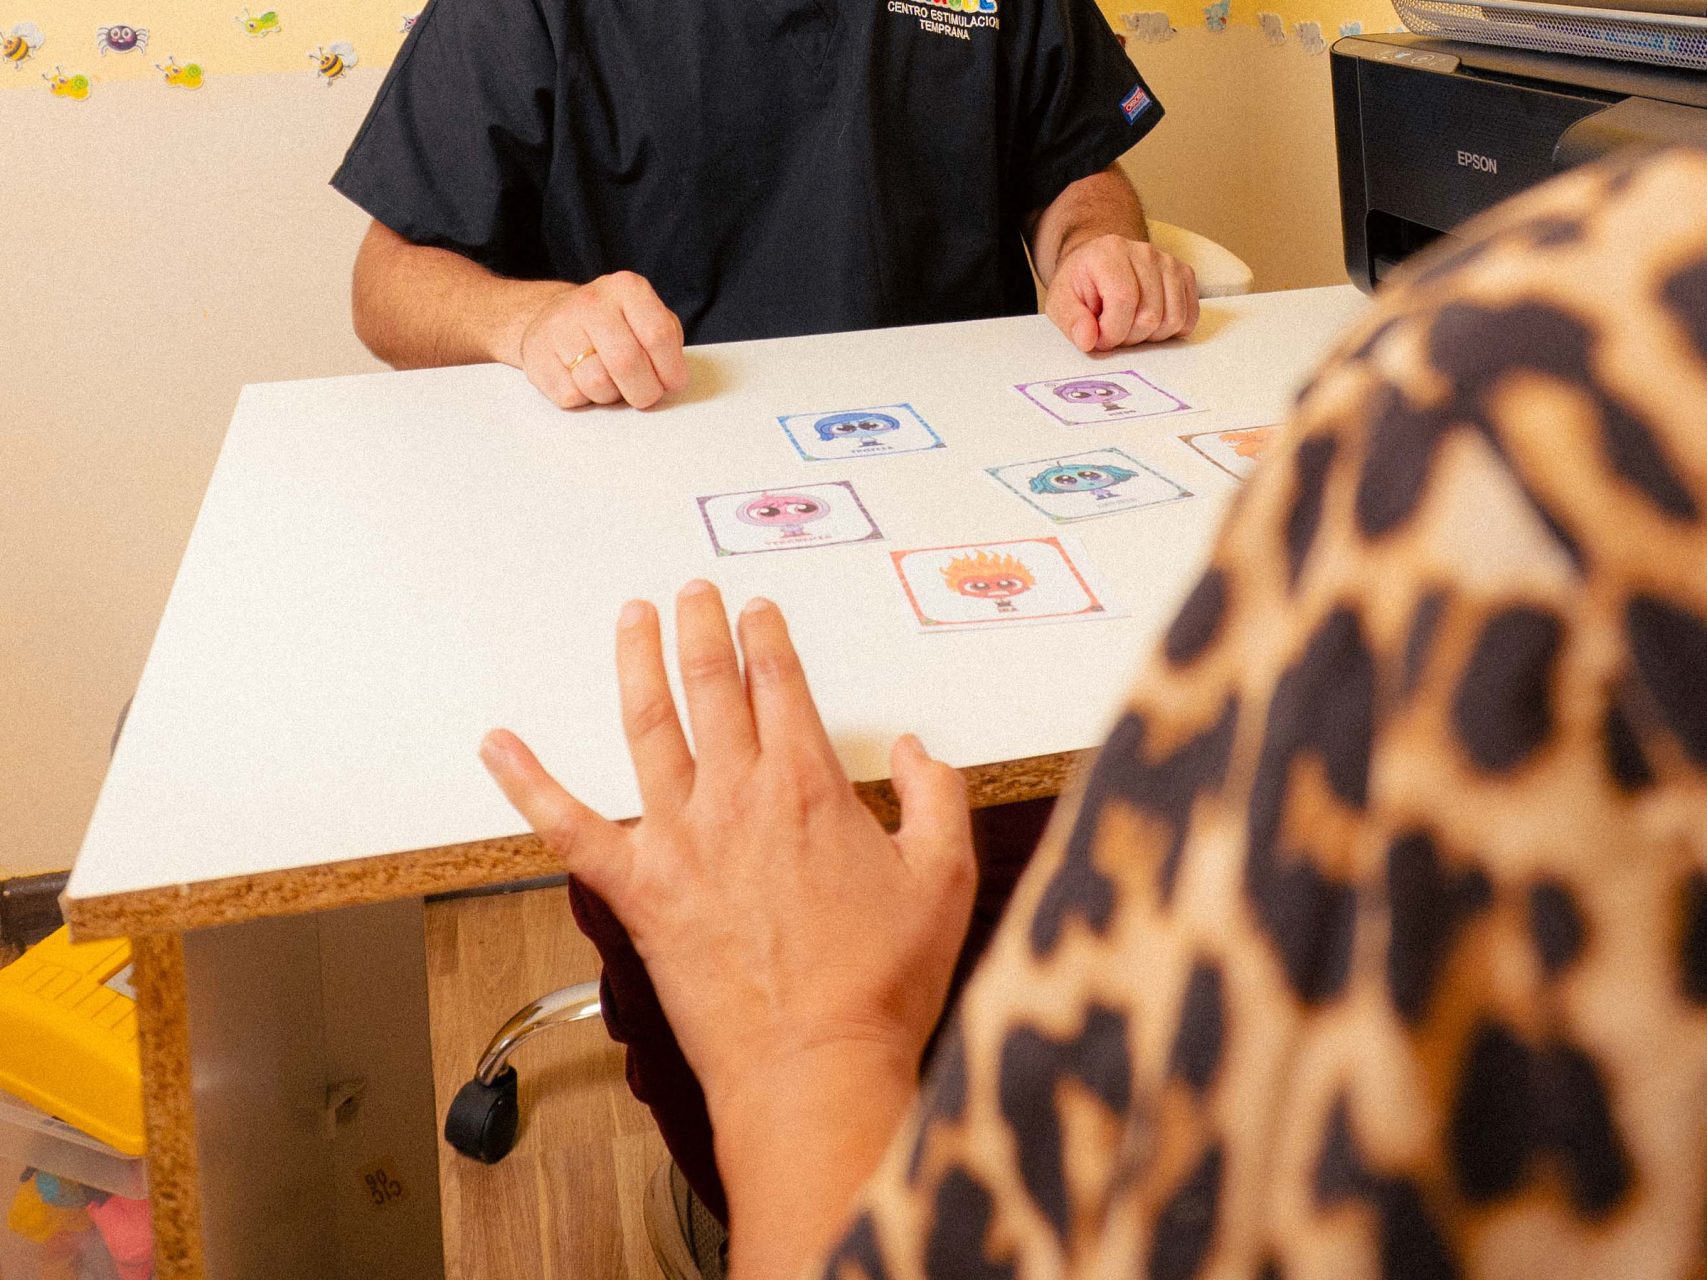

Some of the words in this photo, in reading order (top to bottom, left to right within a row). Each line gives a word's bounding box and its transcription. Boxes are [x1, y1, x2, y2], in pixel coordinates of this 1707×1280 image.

[887, 1, 929, 19] CENTRO
[931, 9, 1000, 30] ESTIMULACION
[919, 19, 971, 40] TEMPRANA
[1457, 150, 1498, 175] EPSON
